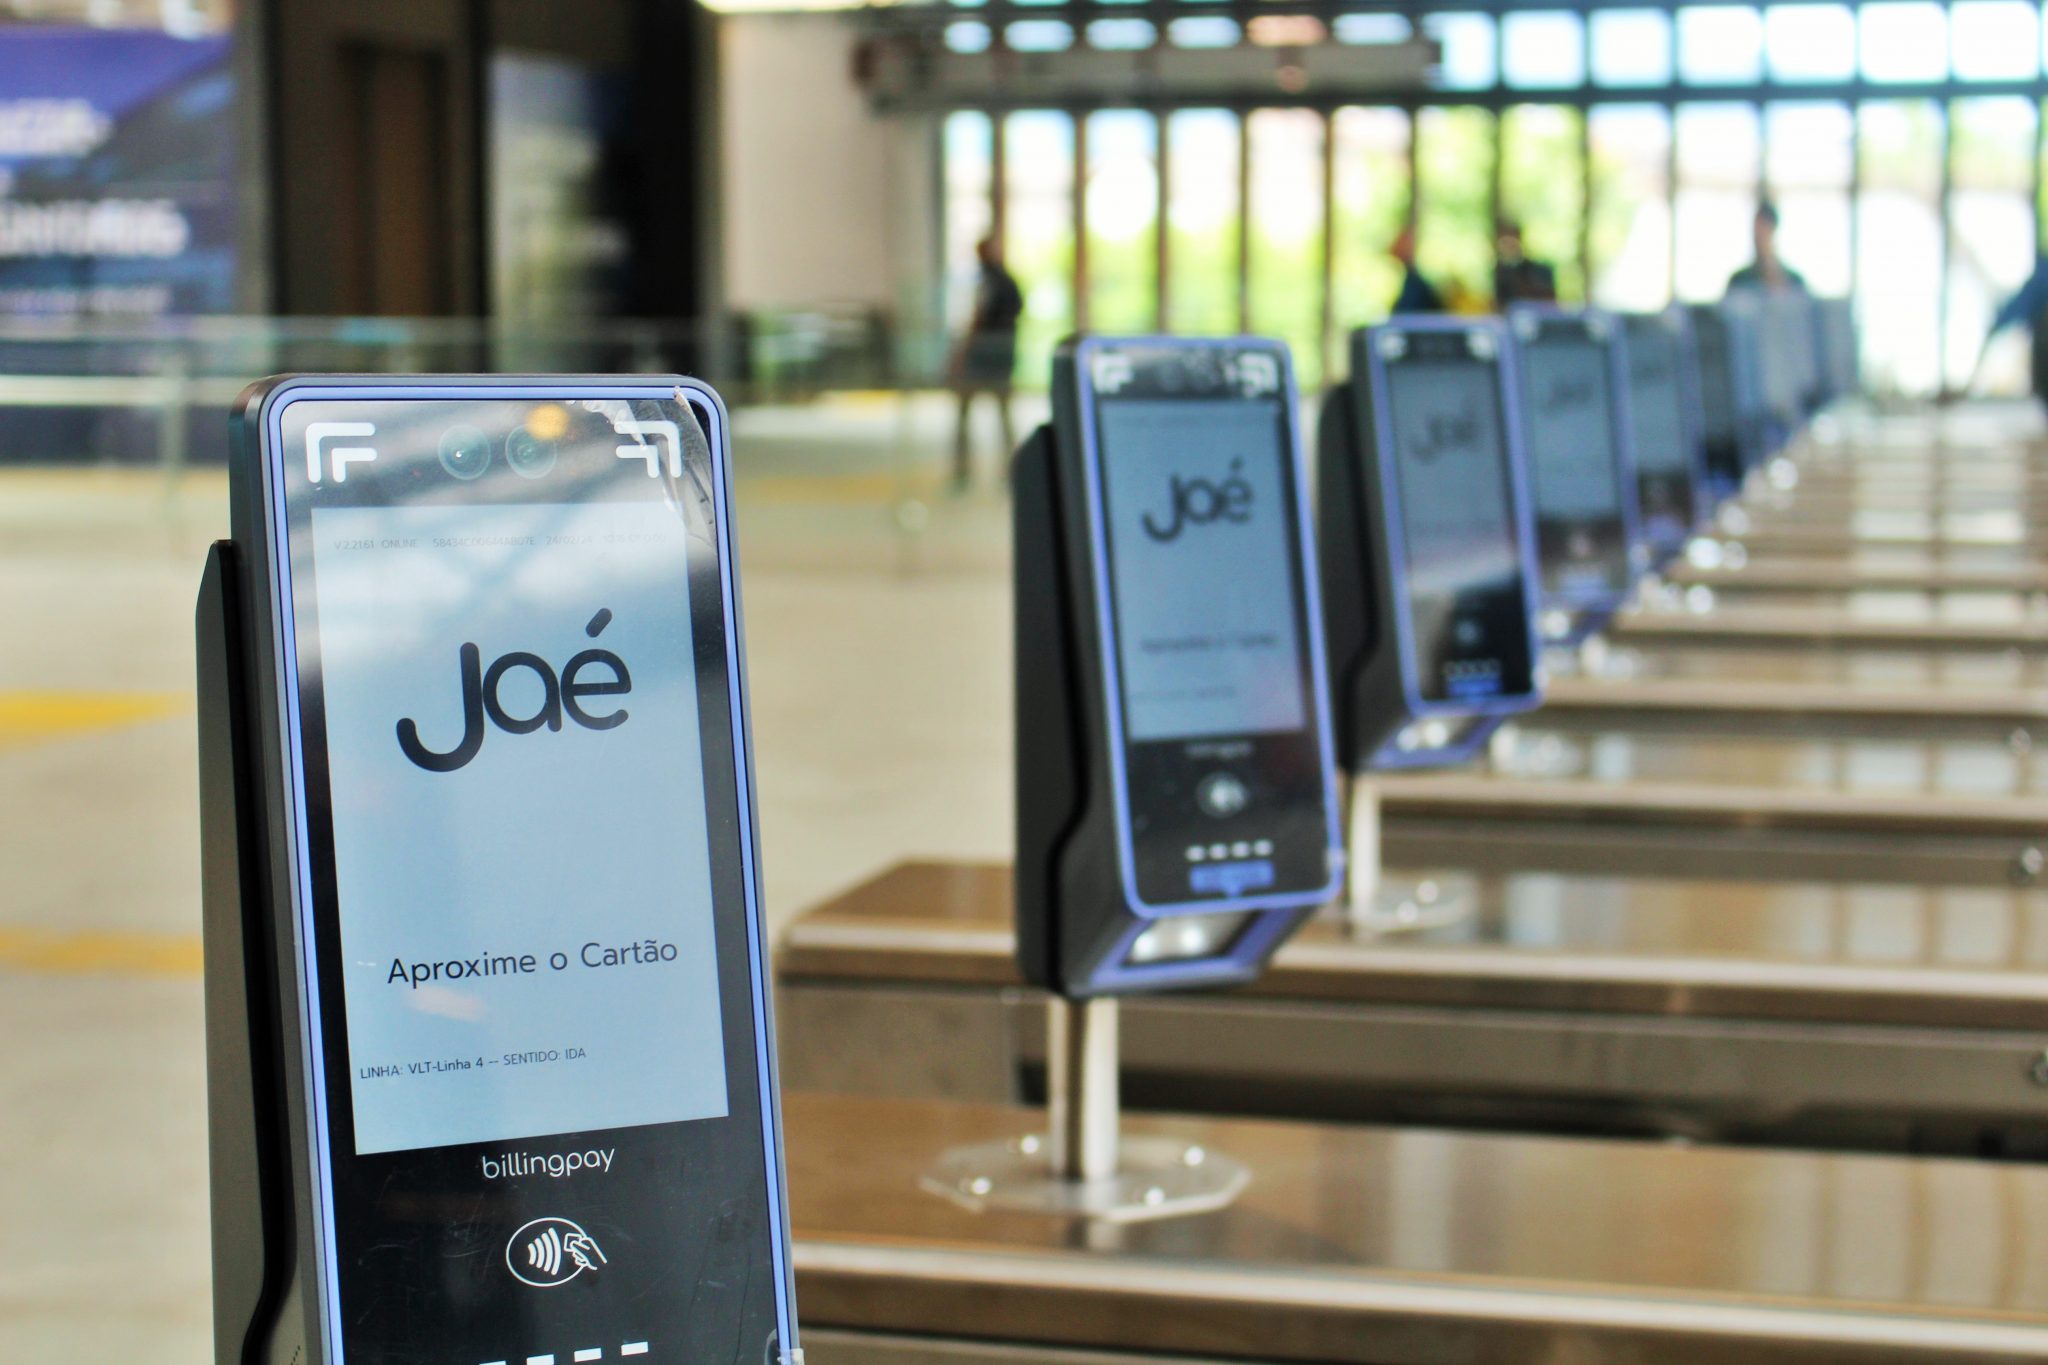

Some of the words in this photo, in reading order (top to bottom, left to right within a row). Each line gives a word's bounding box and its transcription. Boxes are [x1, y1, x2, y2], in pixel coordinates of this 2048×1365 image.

[396, 608, 632, 772] Jaé
[387, 951, 536, 989] Aproxime
[550, 951, 568, 971] o
[581, 939, 678, 968] Cartão
[360, 1064, 403, 1080] LINHA:
[408, 1059, 471, 1075] VLT-Linha
[475, 1056, 484, 1069] 4
[503, 1049, 560, 1067] SENTIDO:
[564, 1048, 587, 1061] IDA
[481, 1147, 616, 1180] billingpay
